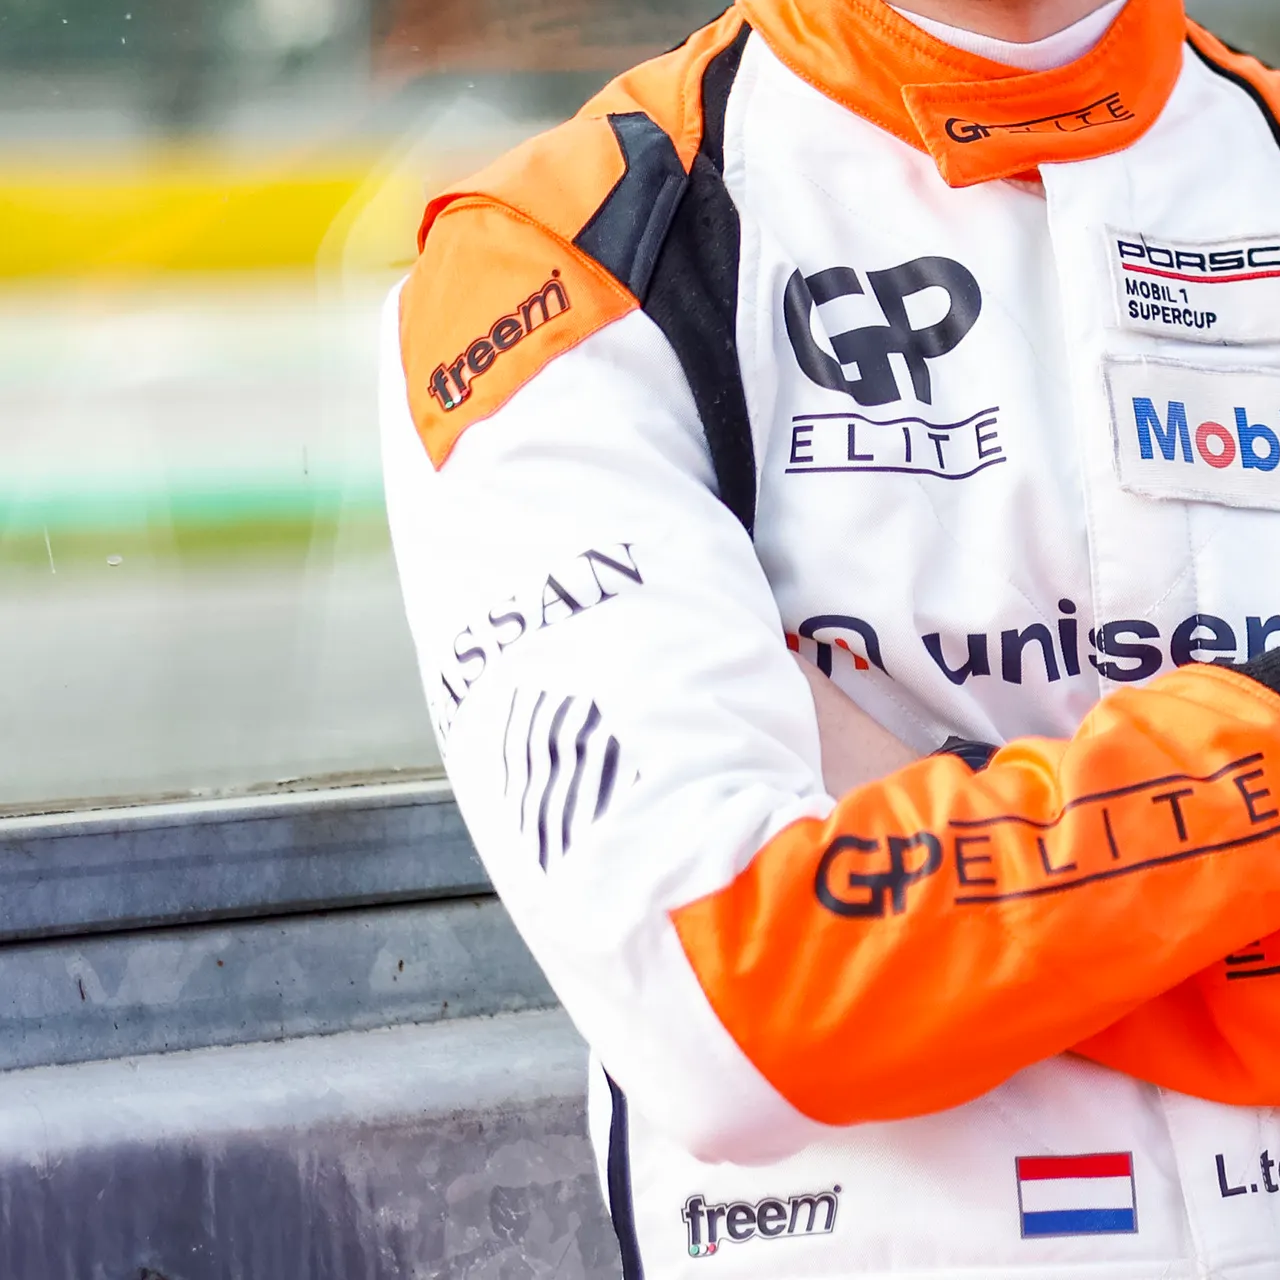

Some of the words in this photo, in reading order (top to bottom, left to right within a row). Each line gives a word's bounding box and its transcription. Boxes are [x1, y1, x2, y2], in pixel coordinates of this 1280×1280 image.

[1125, 277, 1177, 304] MOBIL
[1179, 287, 1189, 305] 1
[1128, 299, 1218, 329] SUPERCUP
[428, 268, 570, 410] freem
[783, 255, 982, 407] GP
[790, 417, 1003, 469] ELITE
[814, 831, 943, 918] GP
[955, 768, 1280, 886] ELITE
[680, 1184, 842, 1258] freem
